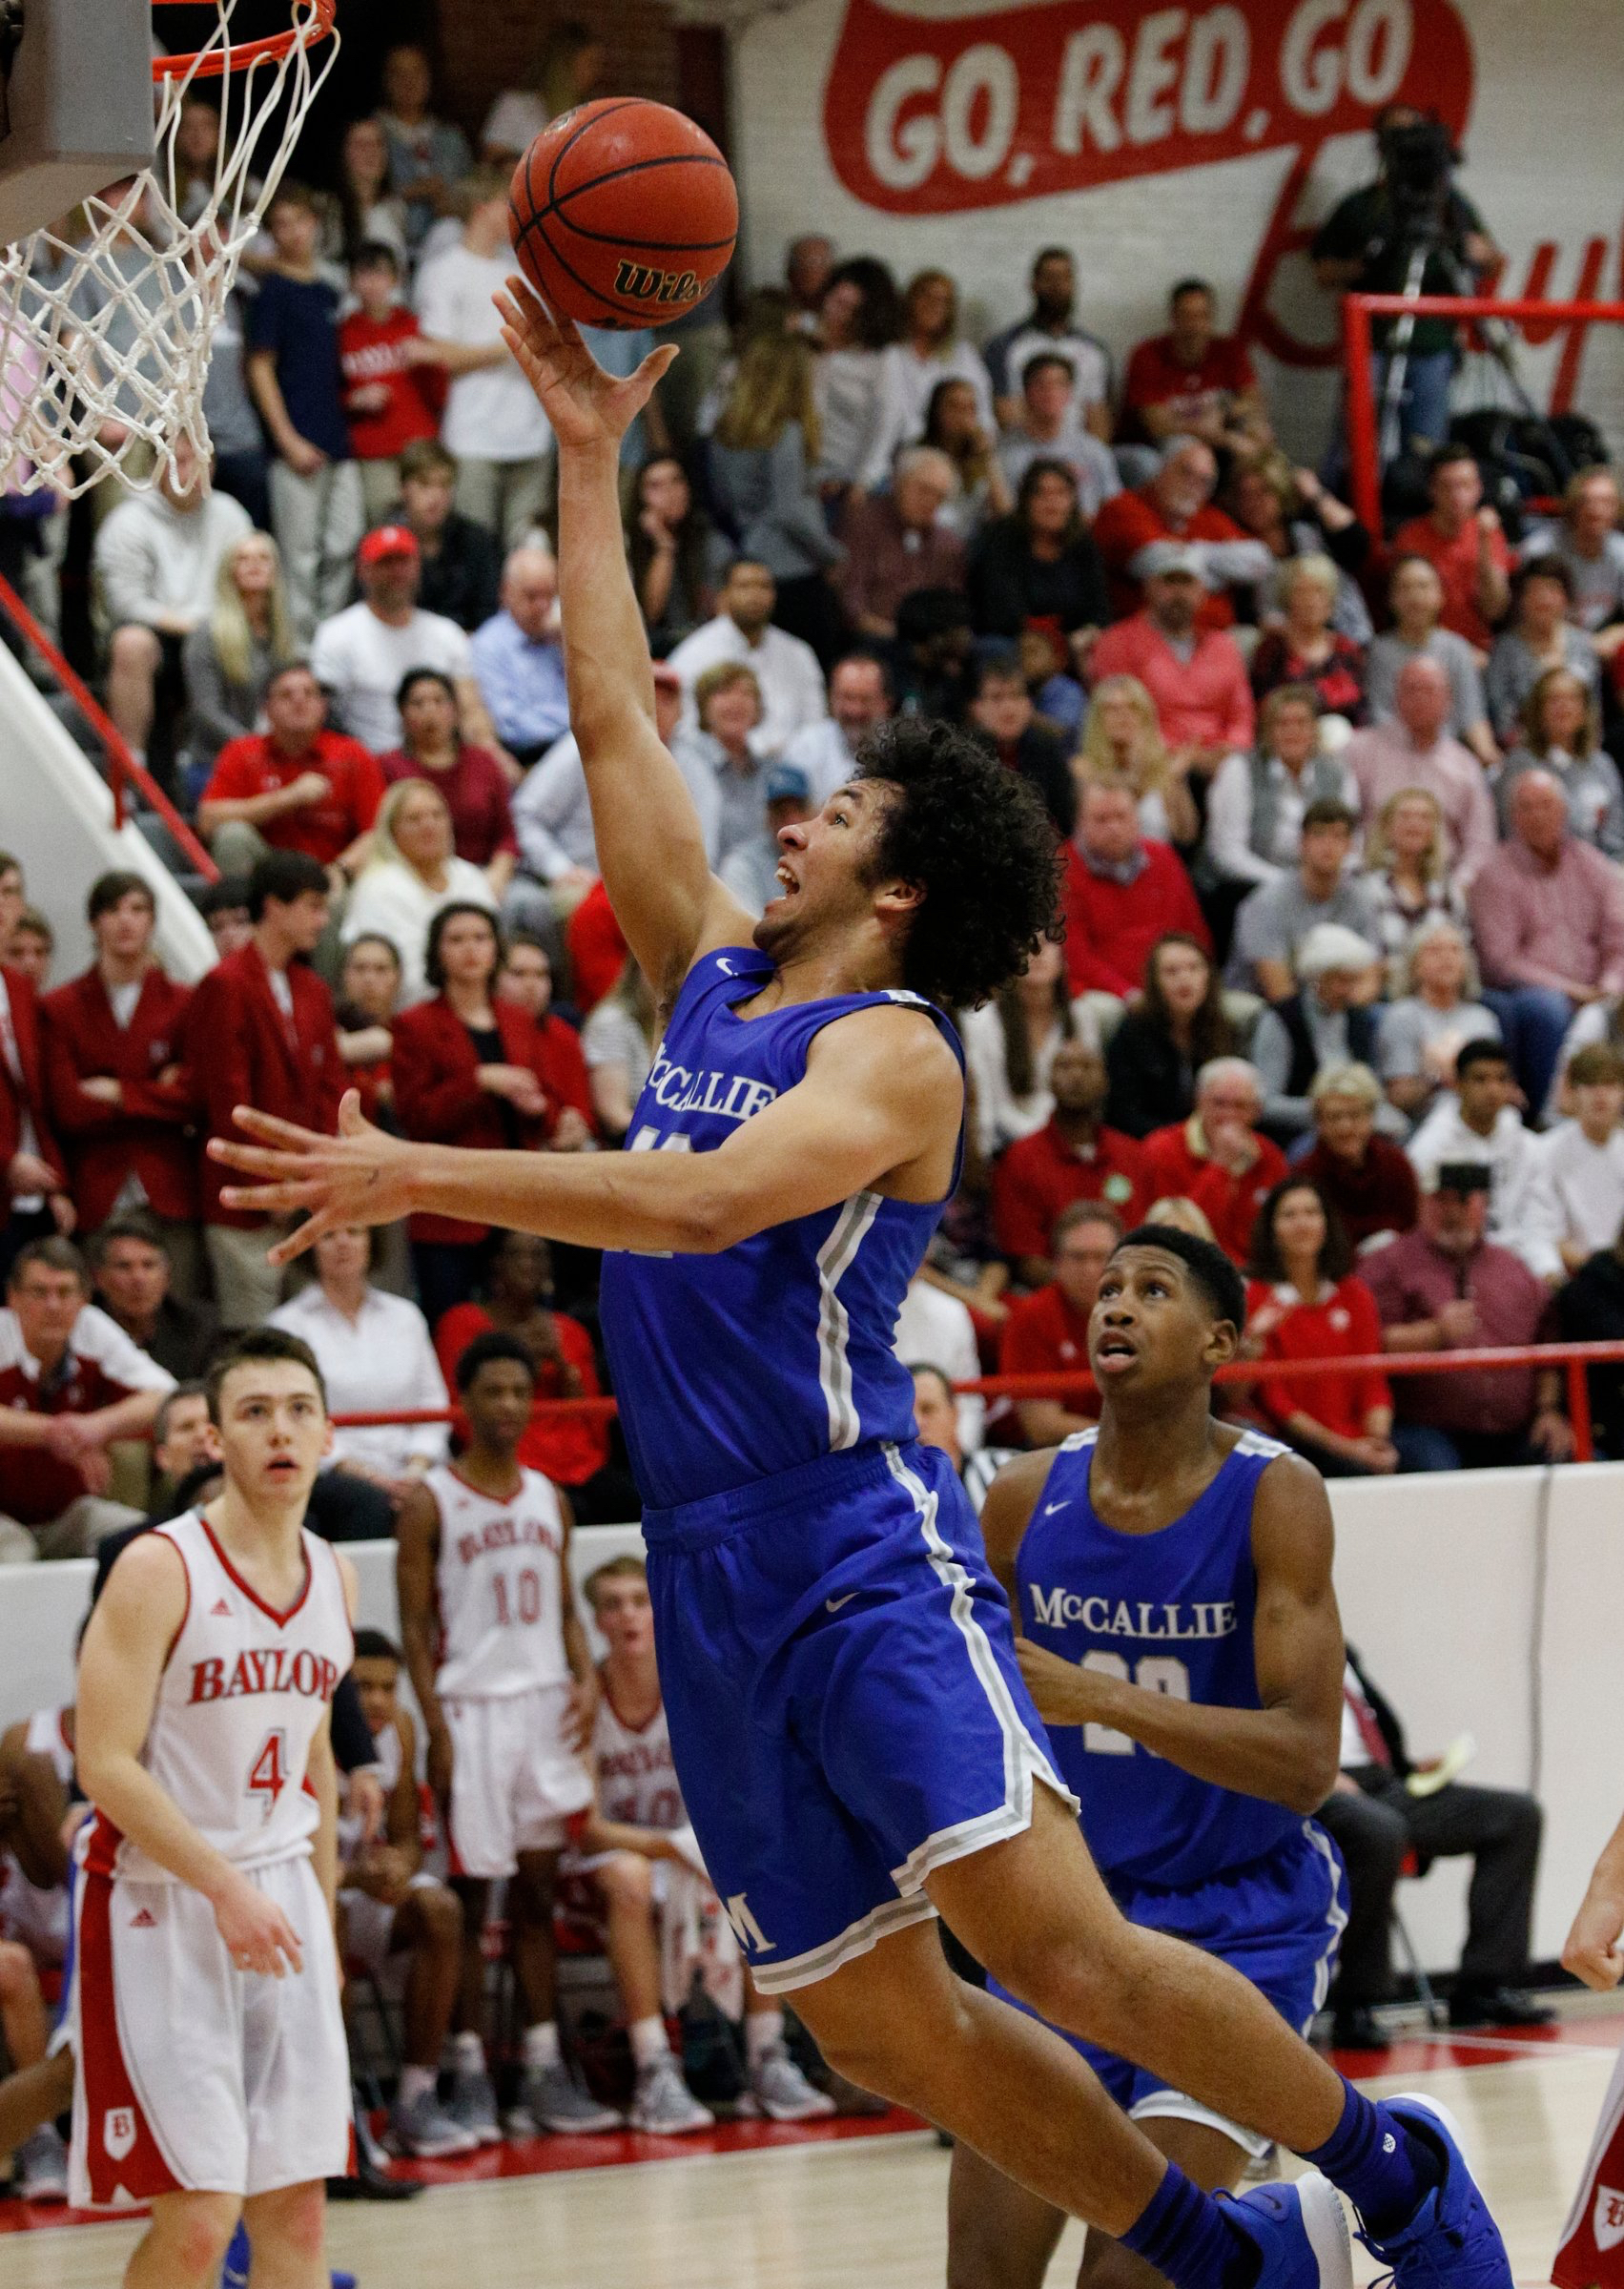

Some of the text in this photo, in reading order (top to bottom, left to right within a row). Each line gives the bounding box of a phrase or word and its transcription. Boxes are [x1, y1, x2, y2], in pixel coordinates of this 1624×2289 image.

[865, 0, 1415, 189] GO, RED, GO
[493, 1569, 541, 1624] 10
[1029, 1582, 1237, 1639] McCALLIE
[245, 1728, 289, 1819] 4
[725, 1892, 777, 1955] M
